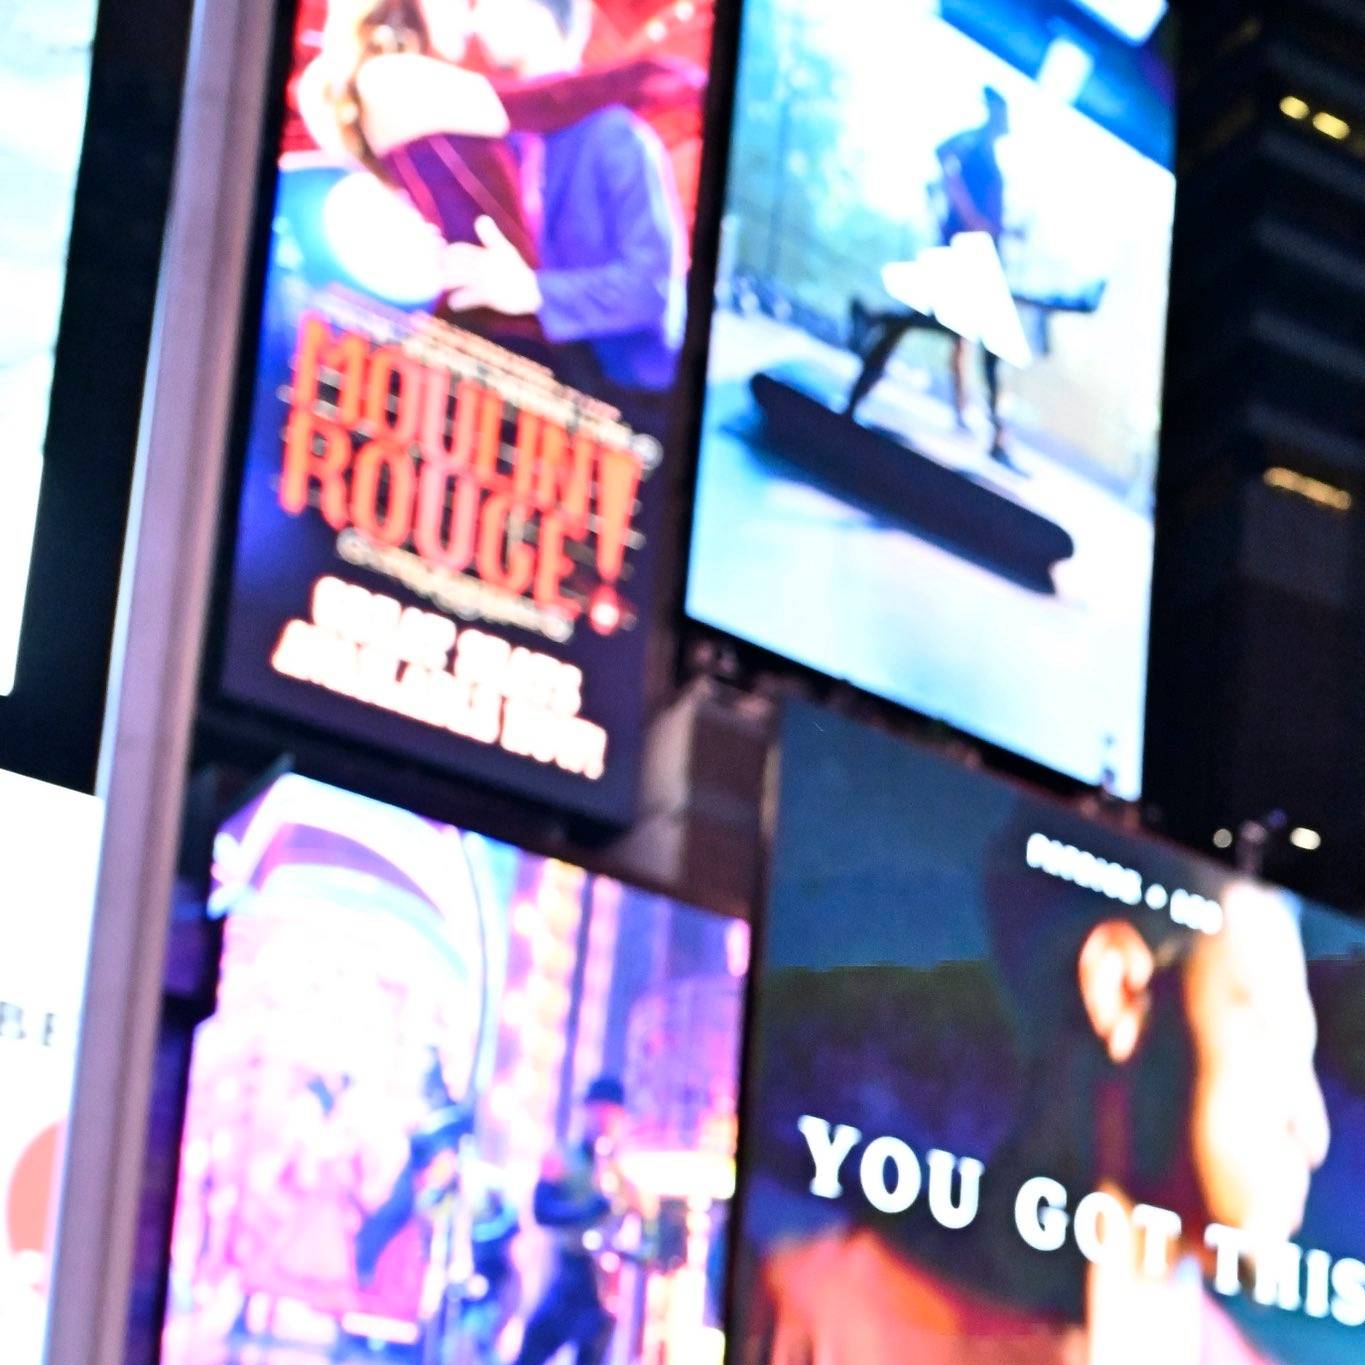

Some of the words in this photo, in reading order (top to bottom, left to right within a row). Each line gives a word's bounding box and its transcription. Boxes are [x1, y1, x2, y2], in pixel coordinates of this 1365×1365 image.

[291, 310, 590, 543] MOULIN
[798, 1114, 985, 1230] YOU
[1014, 1176, 1182, 1280] GOT
